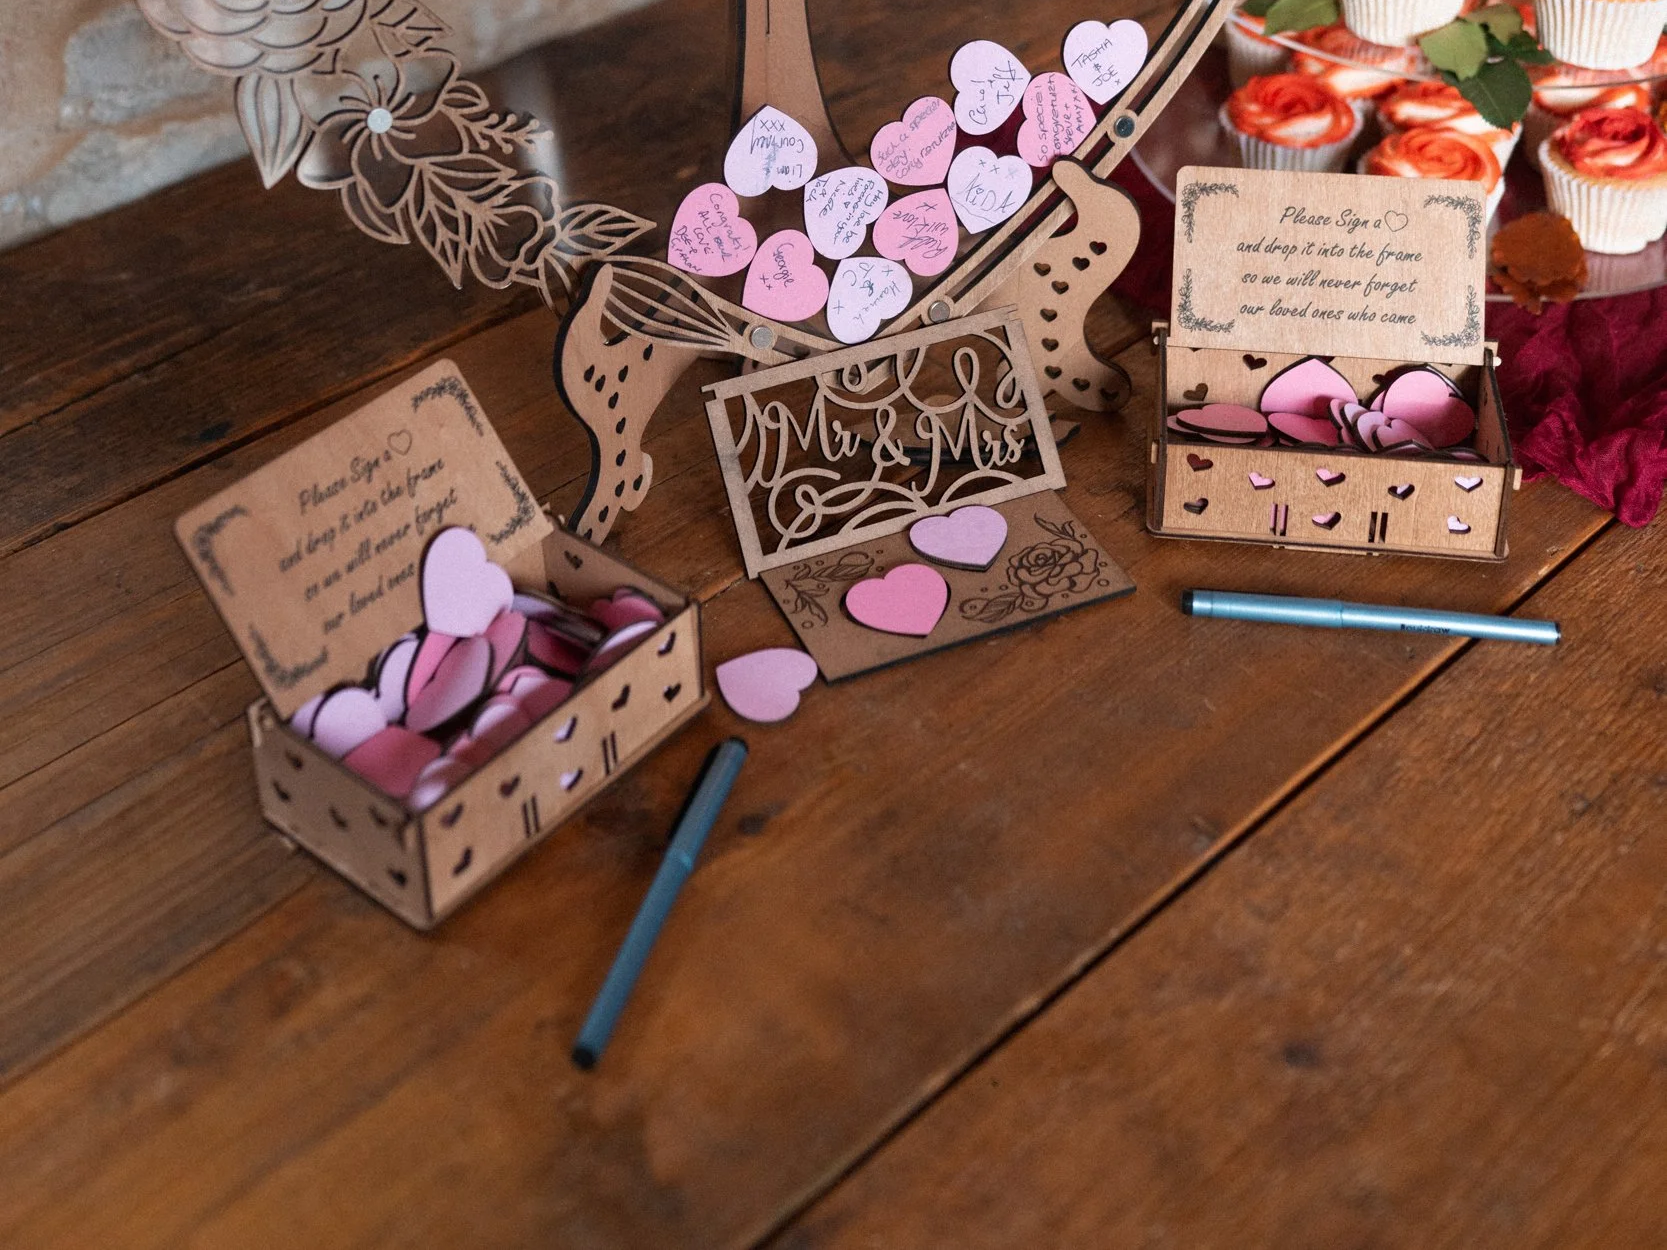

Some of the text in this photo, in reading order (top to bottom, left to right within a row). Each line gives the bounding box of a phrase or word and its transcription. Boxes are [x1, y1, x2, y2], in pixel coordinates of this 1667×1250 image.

[1071, 38, 1113, 68] TASHA
[992, 60, 1024, 106] Jeff
[1092, 64, 1118, 86] JOE
[968, 80, 988, 125] Carol
[776, 164, 802, 183] Liam
[853, 210, 871, 227] love
[1279, 206, 1383, 234] Please Sign a
[842, 230, 858, 244] be
[1236, 237, 1423, 267] and drop it into the frame
[773, 242, 795, 288] Georgie
[1242, 270, 1417, 299] so we will never forget
[853, 280, 902, 324] Hannah
[1240, 299, 1416, 325] our loved ones who came
[758, 374, 1026, 497] Mr & Mrs
[299, 477, 351, 515] Please
[350, 453, 381, 484] Sign
[406, 458, 446, 498] frame
[414, 488, 458, 534] forget
